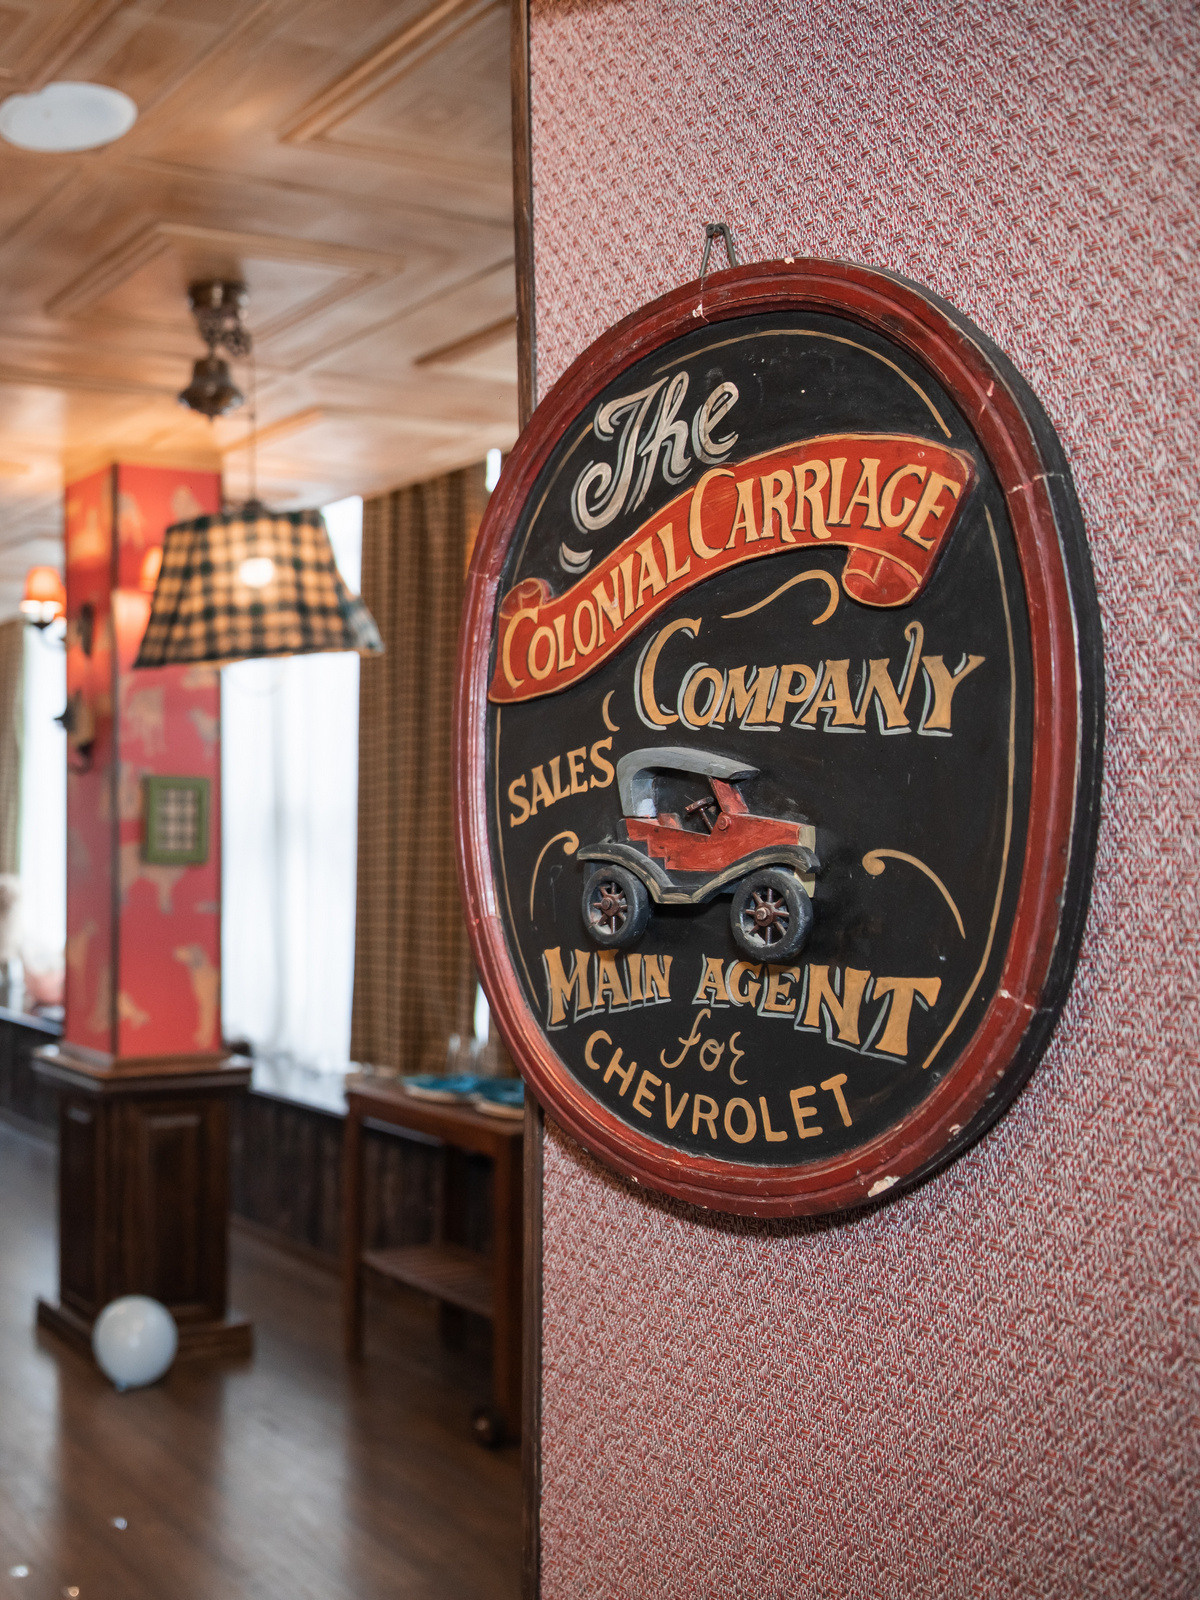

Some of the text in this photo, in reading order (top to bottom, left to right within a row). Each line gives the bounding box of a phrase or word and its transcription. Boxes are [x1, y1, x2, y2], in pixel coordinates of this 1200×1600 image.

[570, 371, 739, 534] The
[502, 456, 961, 690] COLONIAL CARRIAGE
[634, 618, 986, 738] COMPANY
[508, 737, 615, 827] SALES
[542, 946, 942, 1064] MAIN AGENT
[584, 1029, 854, 1144] CHEVROLET
